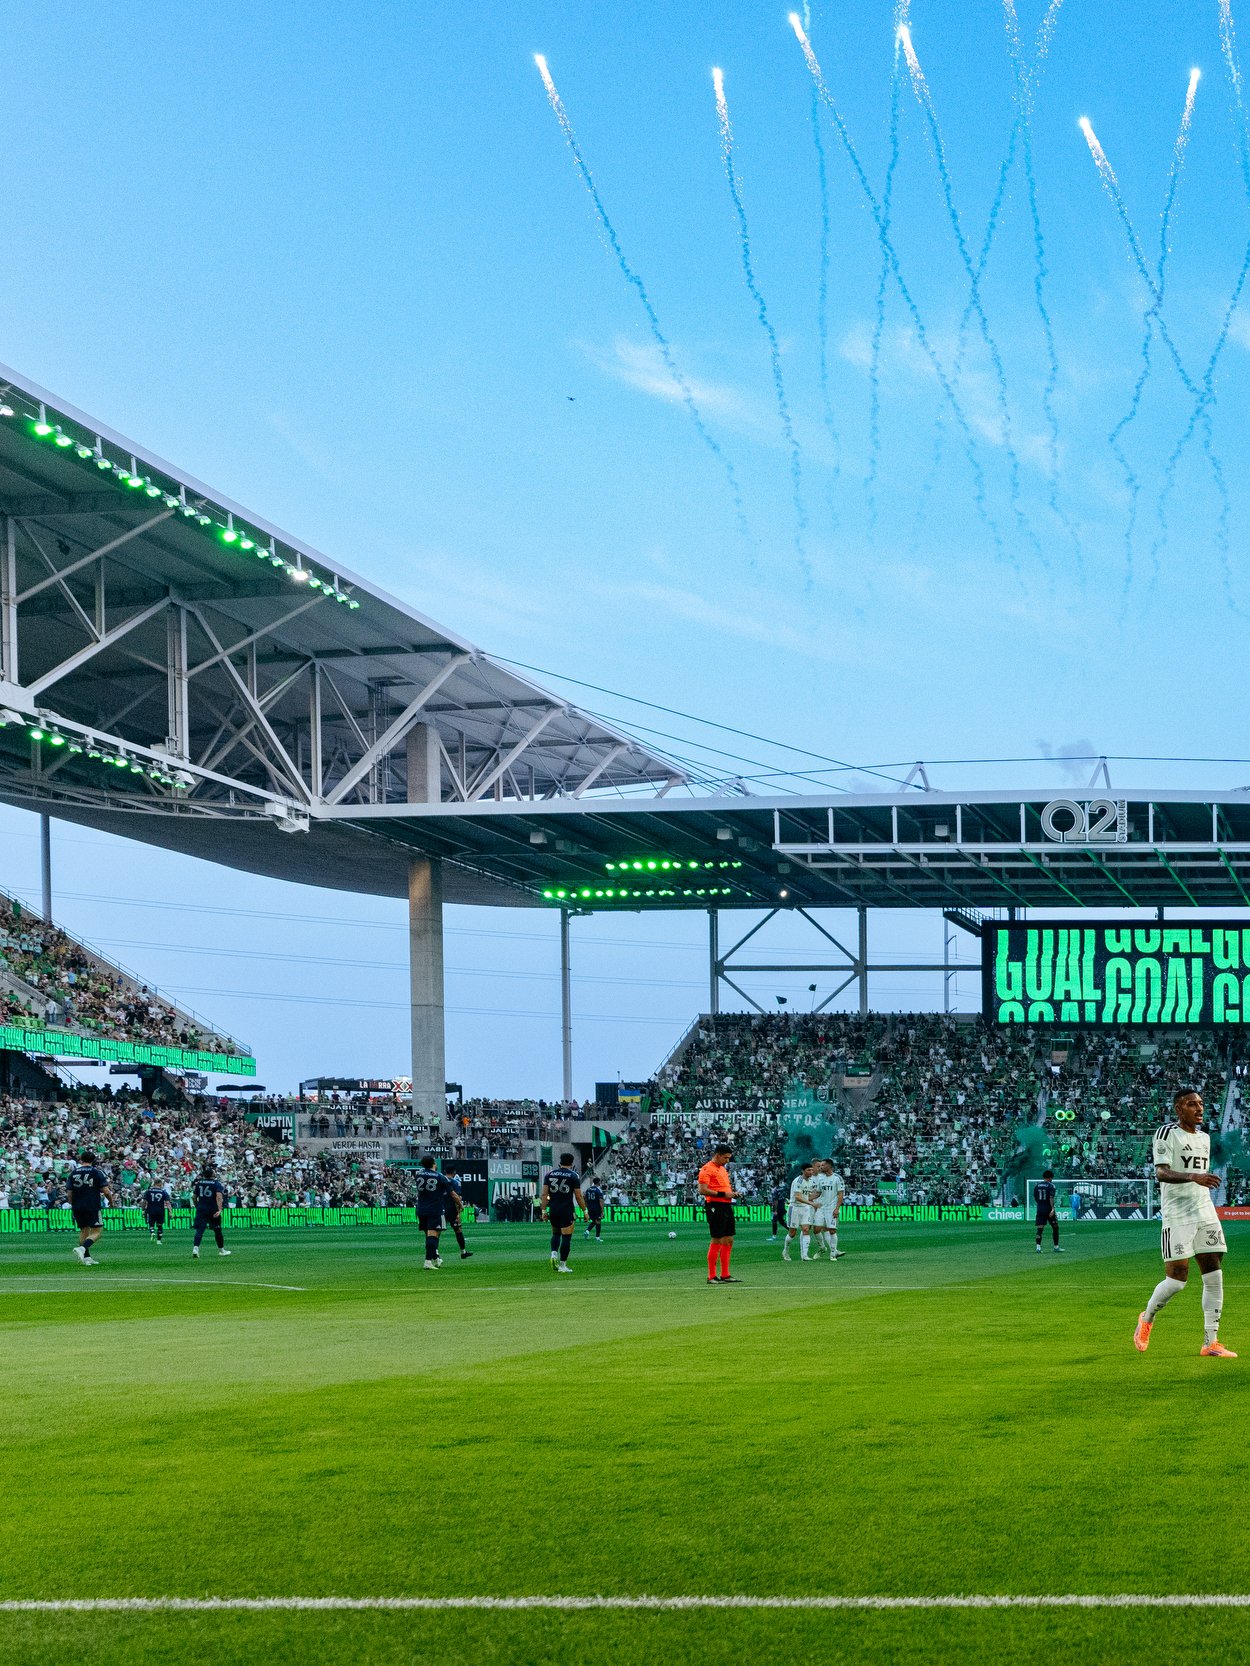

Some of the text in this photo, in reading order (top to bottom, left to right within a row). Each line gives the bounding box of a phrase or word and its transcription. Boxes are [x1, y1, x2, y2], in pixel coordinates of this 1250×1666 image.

[1041, 798, 1117, 843] Q2
[1117, 799, 1128, 843] STADIUM
[257, 1116, 293, 1128] AUSTIN
[281, 1129, 294, 1141] FC
[332, 1141, 380, 1150] VERDE HASTA
[1180, 1155, 1209, 1169] YET
[490, 1163, 520, 1175] JABIL
[72, 1173, 94, 1188] 34
[453, 1173, 487, 1182] ABIL
[416, 1177, 438, 1191] 28
[549, 1177, 570, 1193] 36
[150, 1192, 163, 1202] 19
[199, 1185, 212, 1198] 16
[1038, 1189, 1047, 1200] 11
[988, 1209, 1022, 1219] chime
[0, 1209, 21, 1232] OAL
